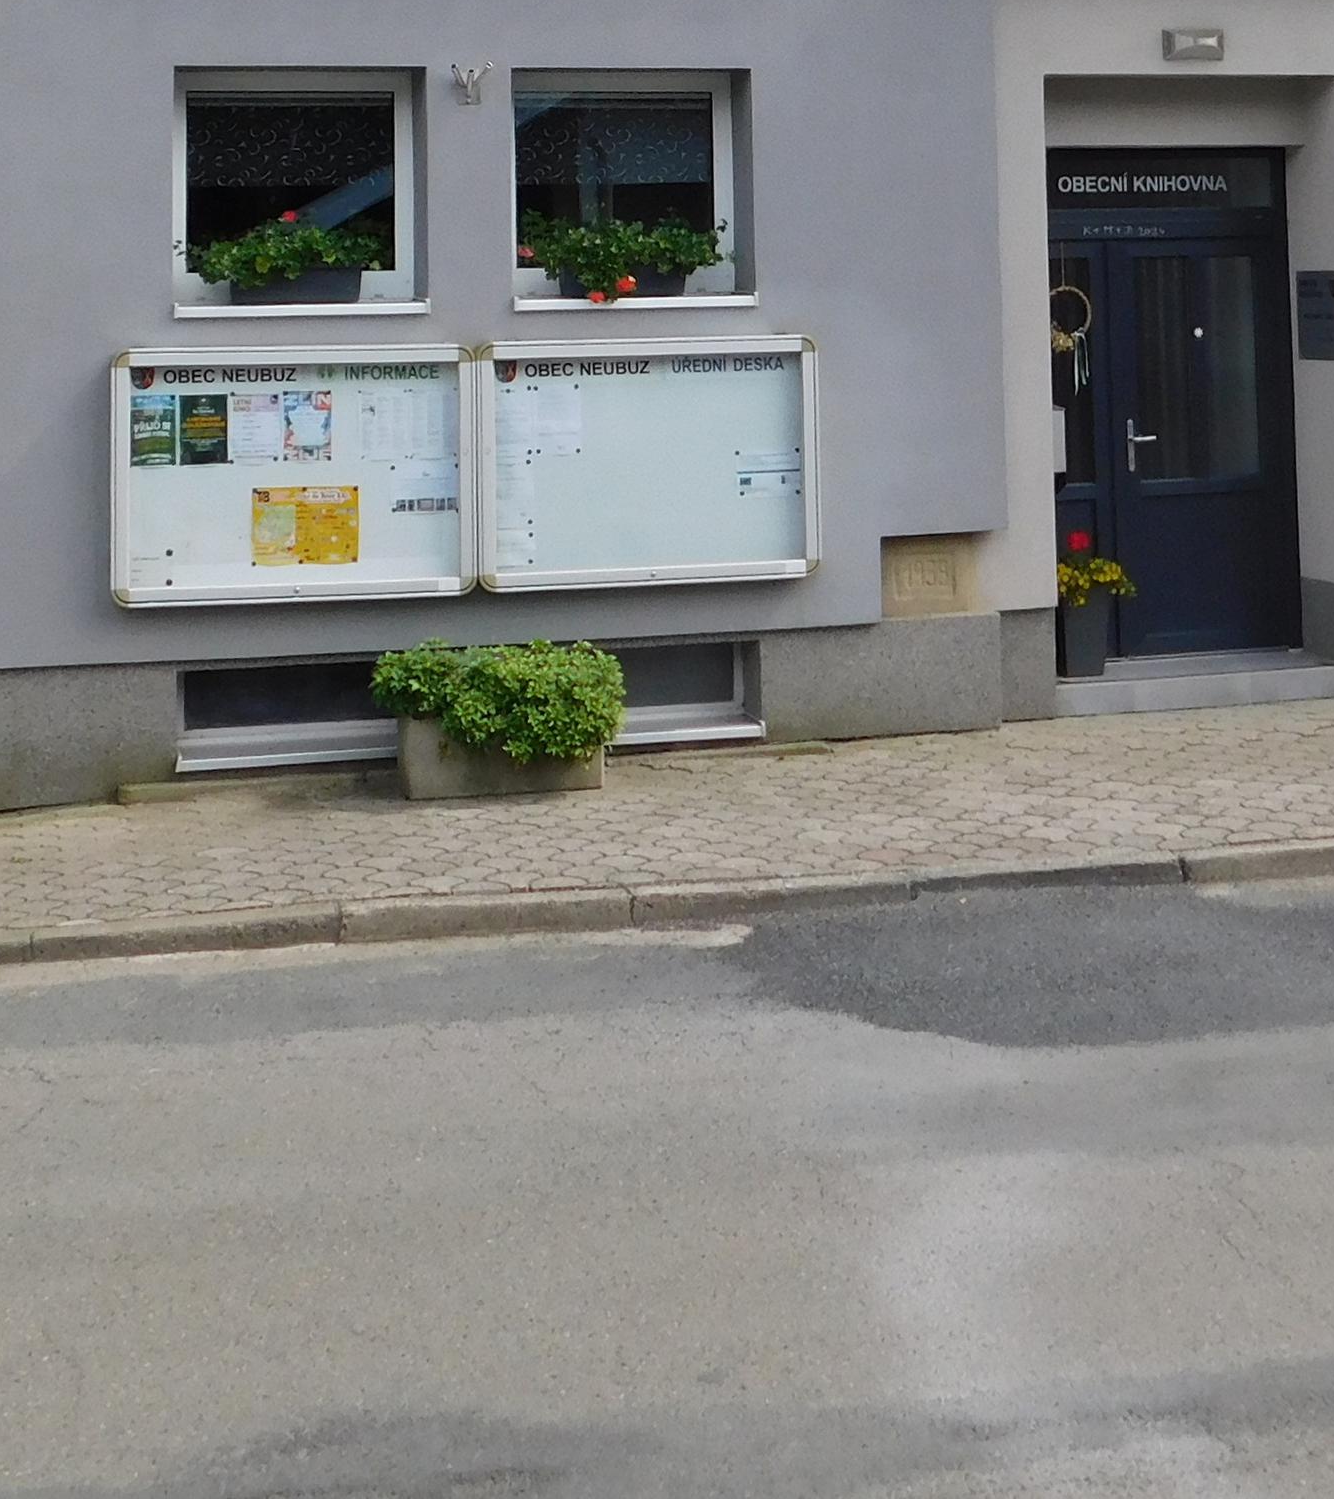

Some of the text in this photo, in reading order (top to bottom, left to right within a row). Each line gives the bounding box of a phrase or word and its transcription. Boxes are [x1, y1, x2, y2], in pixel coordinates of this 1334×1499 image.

[1058, 172, 1228, 193] OBECNÍ KNIHOVNA
[163, 364, 440, 384] OBEC NEUBUZ INFORMACE
[524, 355, 785, 378] OBEC NEUBUZ ÚŘEDNÍ DESKA
